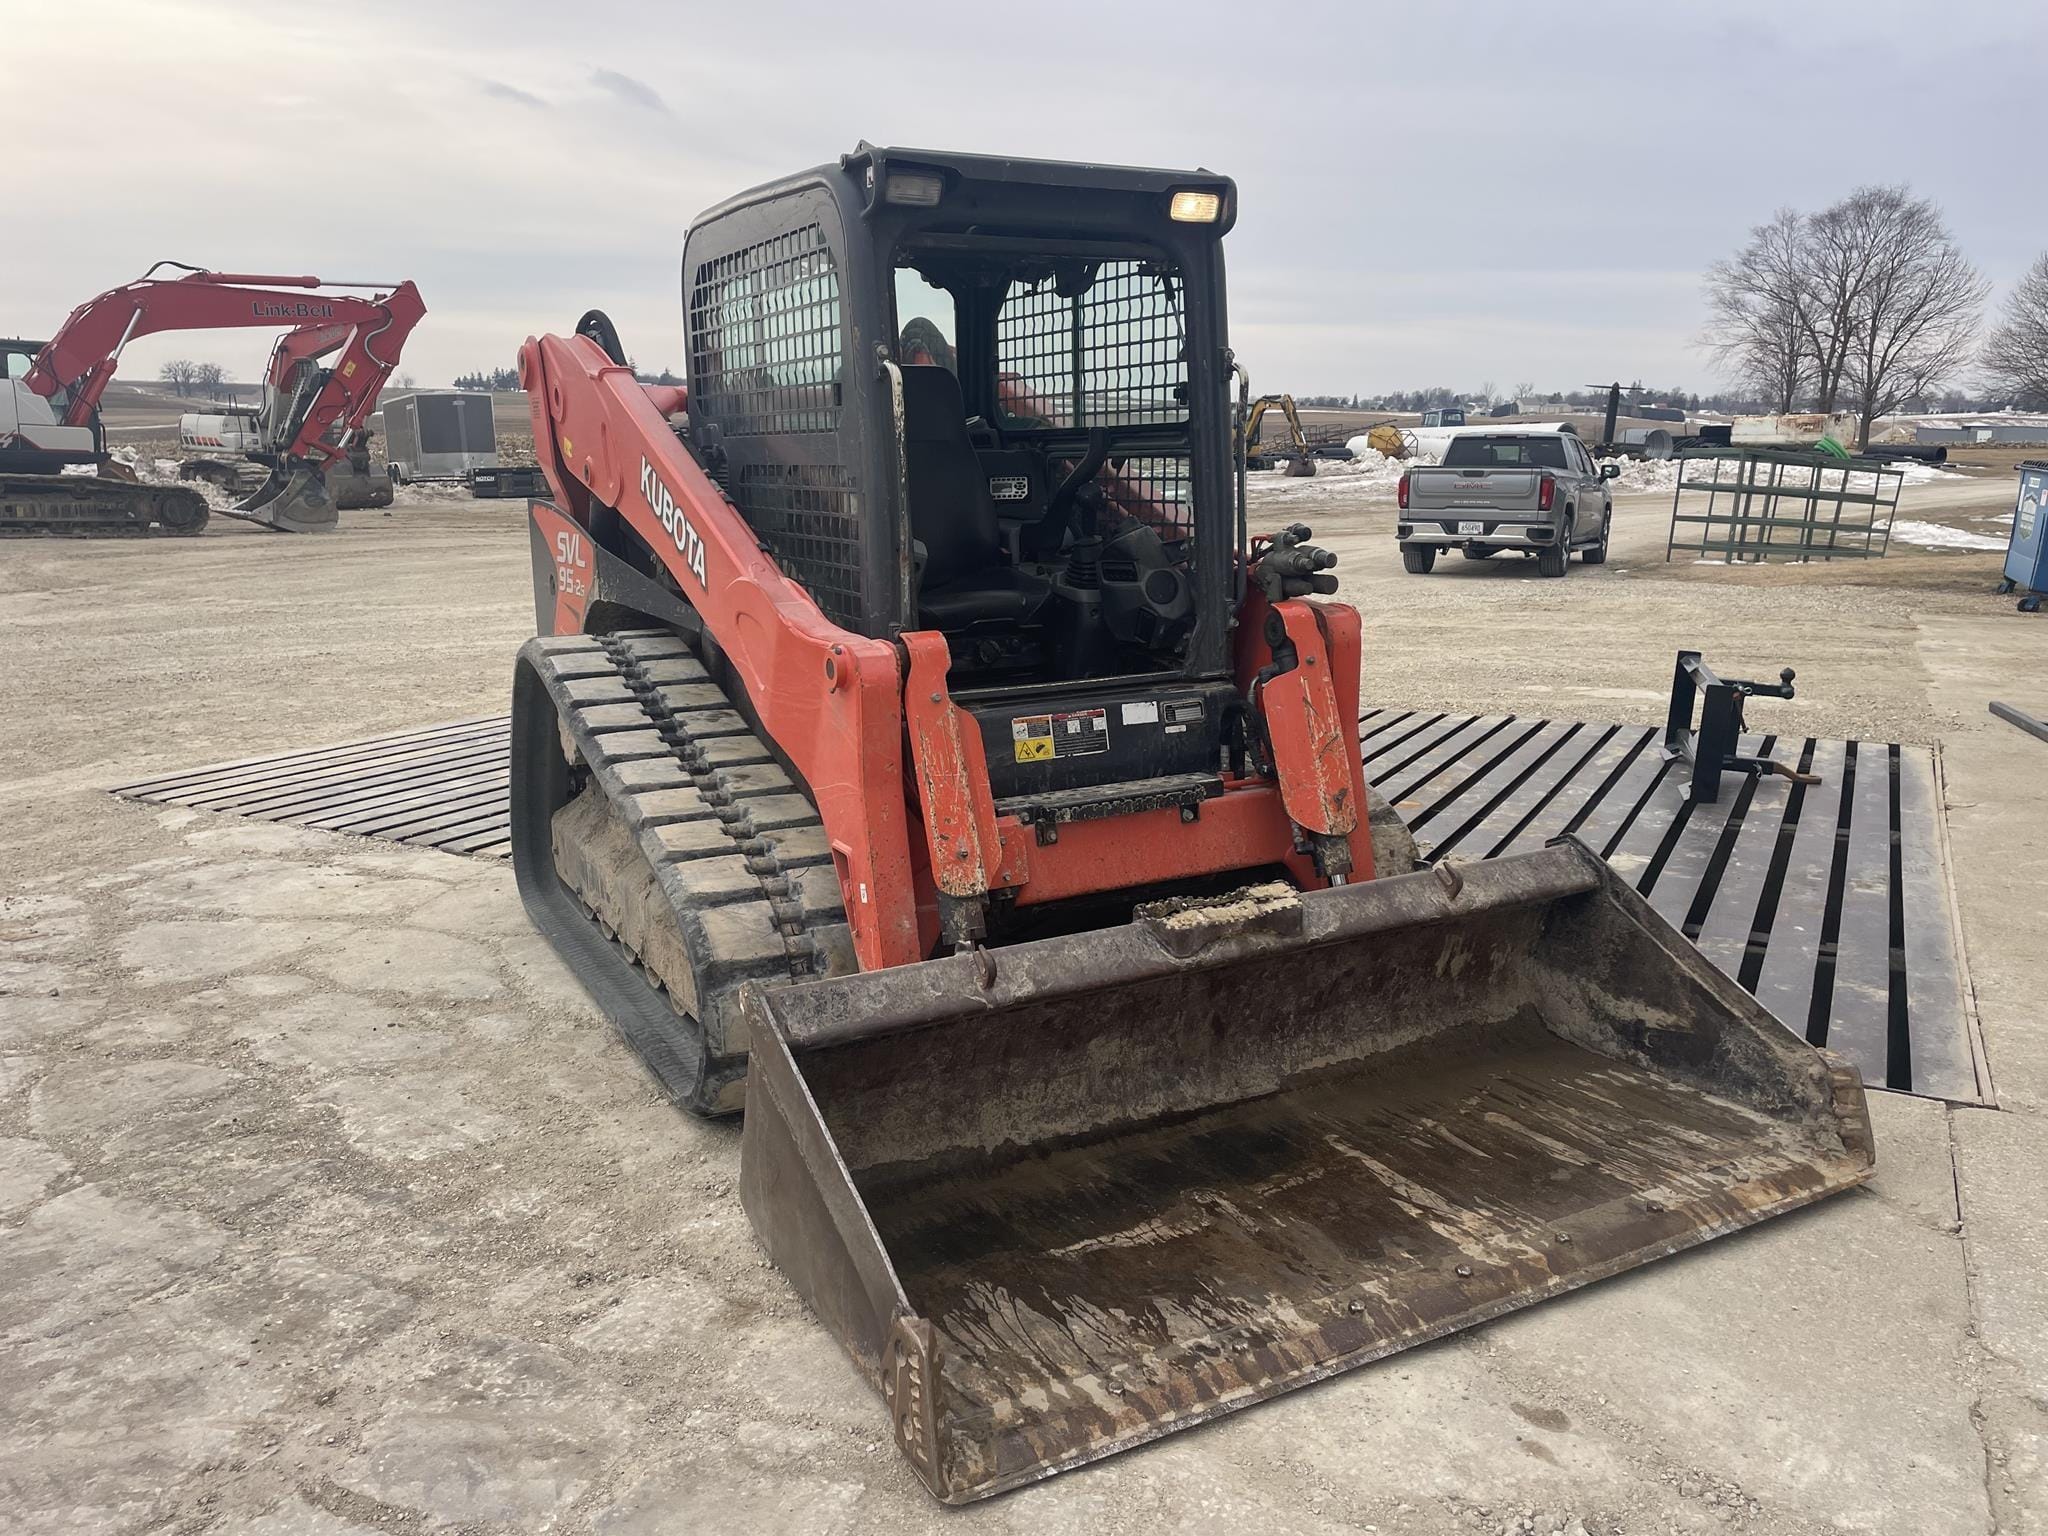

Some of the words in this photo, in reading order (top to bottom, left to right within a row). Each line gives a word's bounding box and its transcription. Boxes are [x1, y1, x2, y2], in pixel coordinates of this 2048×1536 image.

[252, 301, 333, 317] Link-Belt
[640, 454, 706, 589] KUBOTA
[557, 531, 586, 568] SVL
